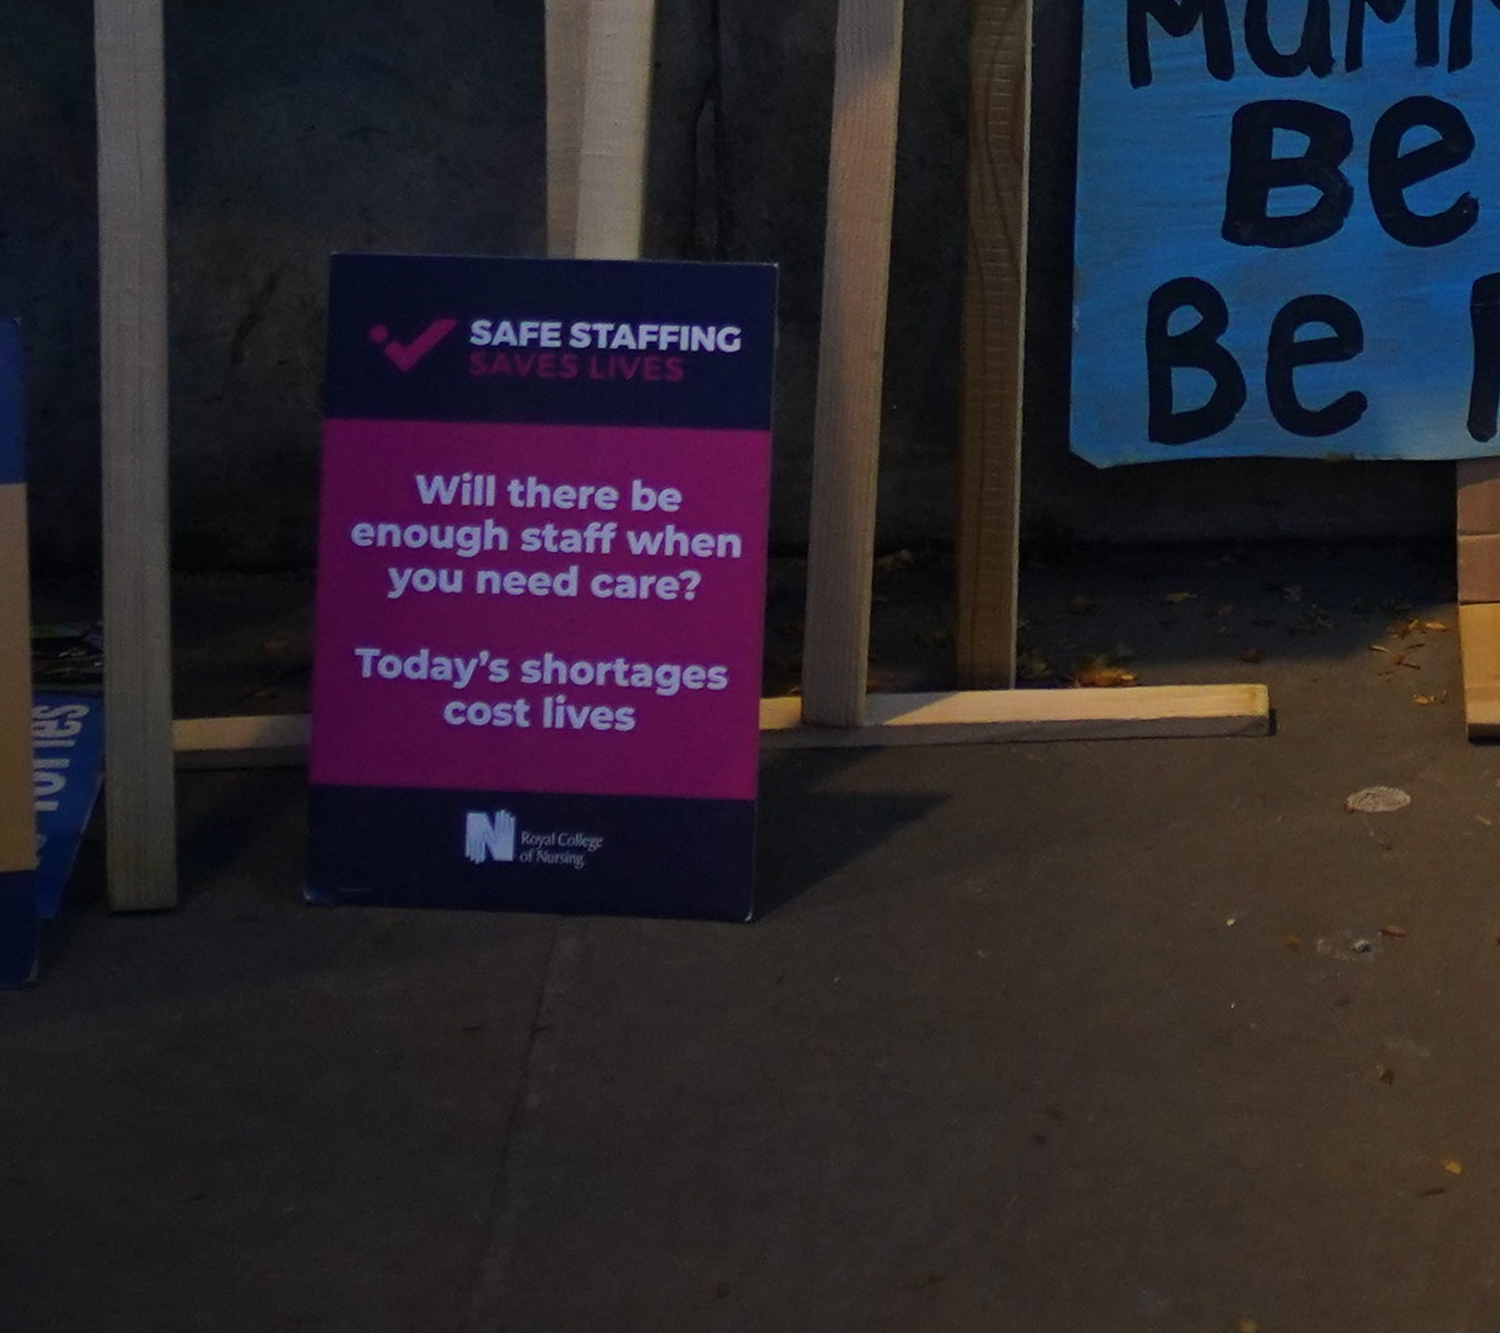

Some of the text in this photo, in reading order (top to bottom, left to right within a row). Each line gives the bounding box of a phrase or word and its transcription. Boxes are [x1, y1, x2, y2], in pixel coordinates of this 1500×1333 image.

[1222, 94, 1479, 248] Be
[469, 319, 741, 353] SAFE STAFFING
[468, 351, 684, 381] SAVES LIVES
[1147, 275, 1369, 445] Be
[416, 474, 682, 512] Will there be
[352, 519, 742, 559] enough staff when
[388, 567, 700, 600] you need care?
[521, 651, 728, 693] shortages
[443, 696, 636, 731] cost lives
[521, 831, 603, 851] Royal College
[519, 850, 584, 869] of Nursing
